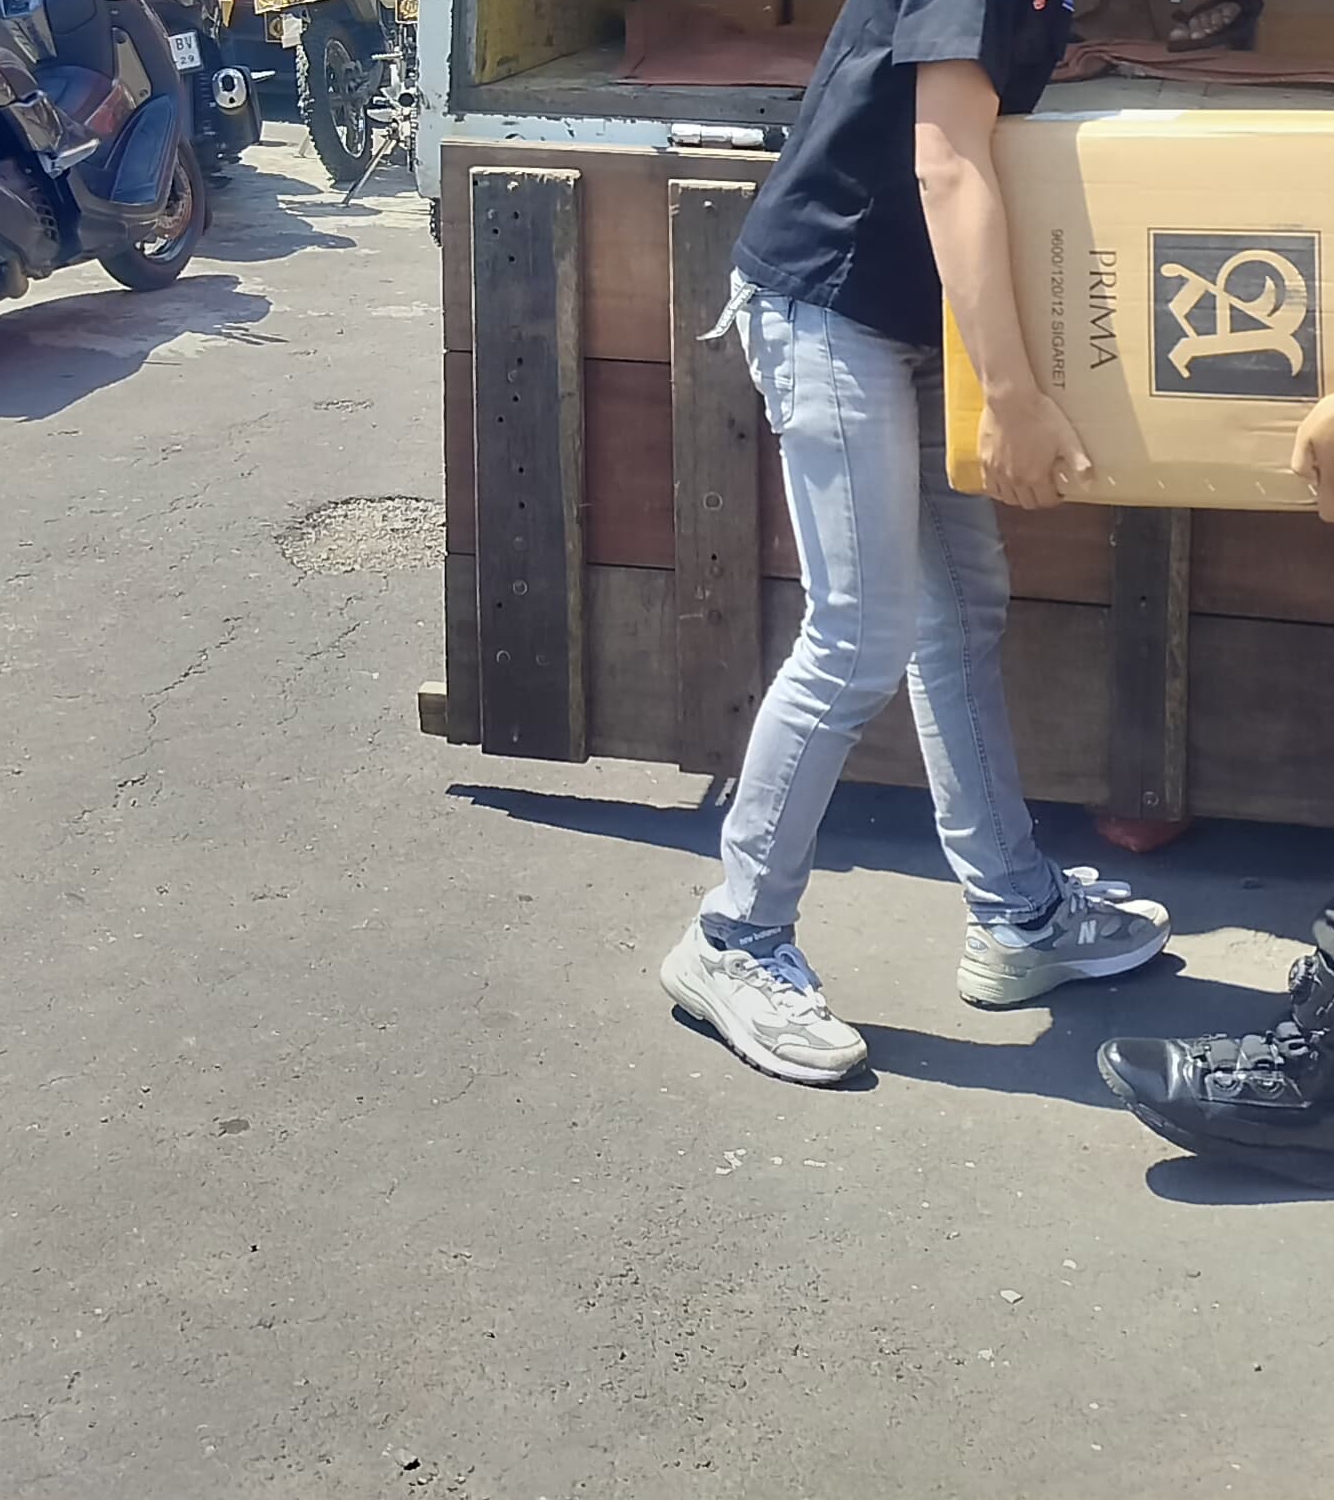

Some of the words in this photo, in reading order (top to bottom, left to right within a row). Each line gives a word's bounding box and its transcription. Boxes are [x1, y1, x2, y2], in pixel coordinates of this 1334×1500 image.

[1051, 228, 1064, 317] 9600/120/12
[1089, 250, 1118, 370] PRIMA
[1051, 320, 1066, 390] SIGARET
